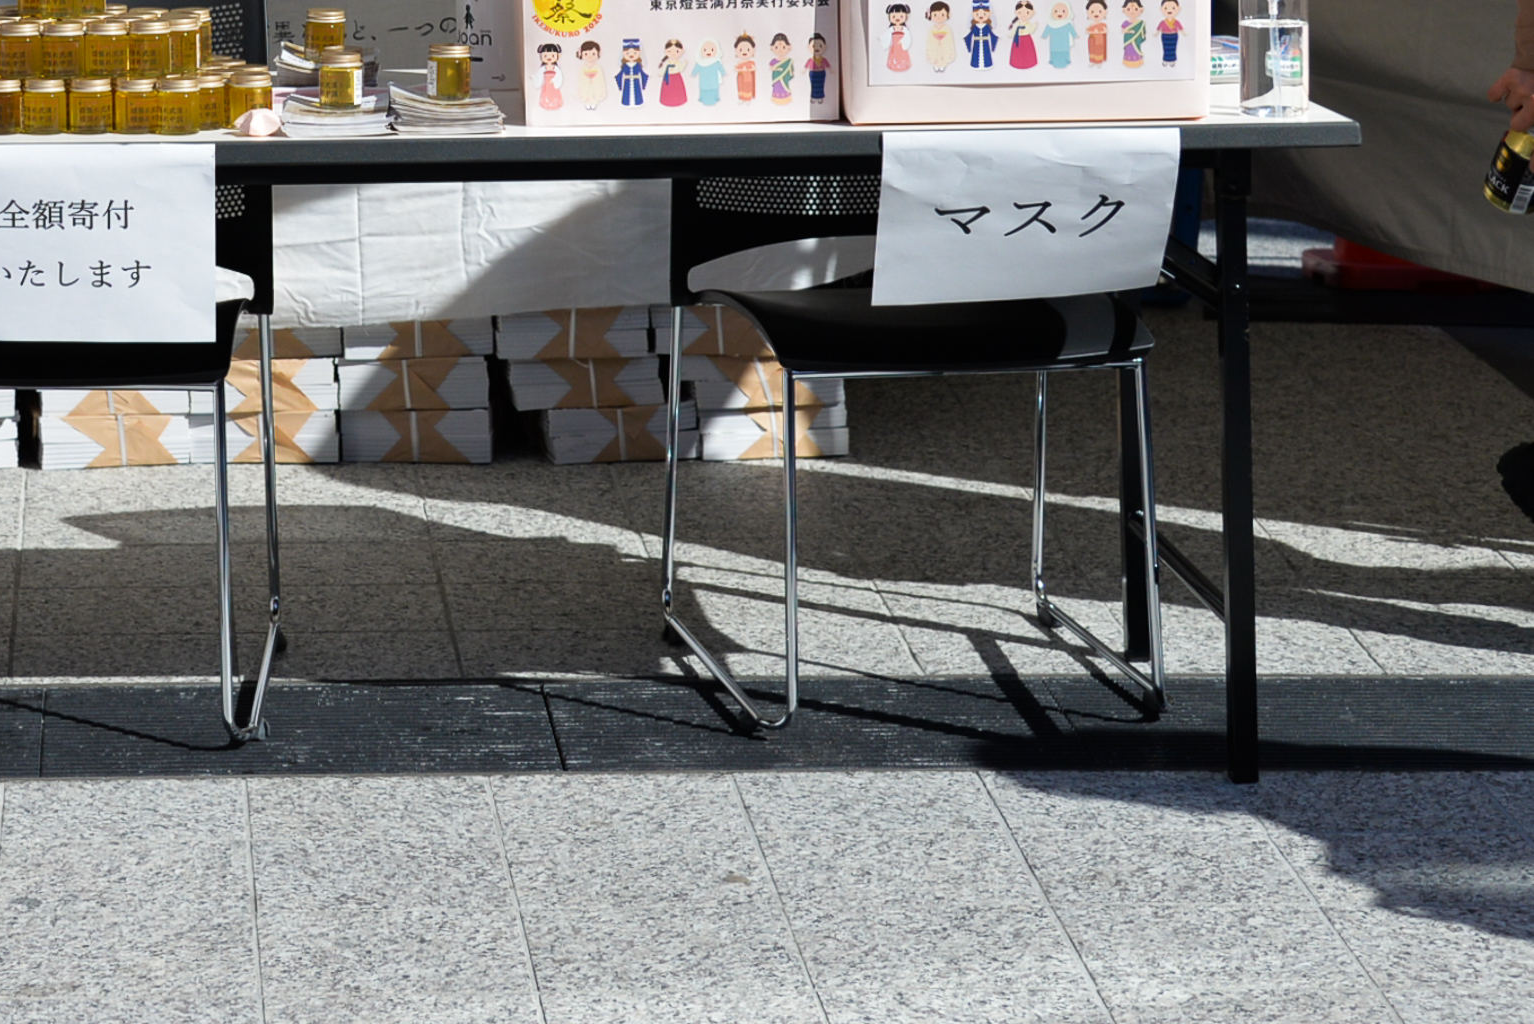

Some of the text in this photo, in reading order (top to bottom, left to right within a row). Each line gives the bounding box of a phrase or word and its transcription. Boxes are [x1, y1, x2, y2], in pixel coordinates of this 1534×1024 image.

[531, 12, 604, 38] IKEBUKURO 2020
[933, 193, 1126, 238] マスク
